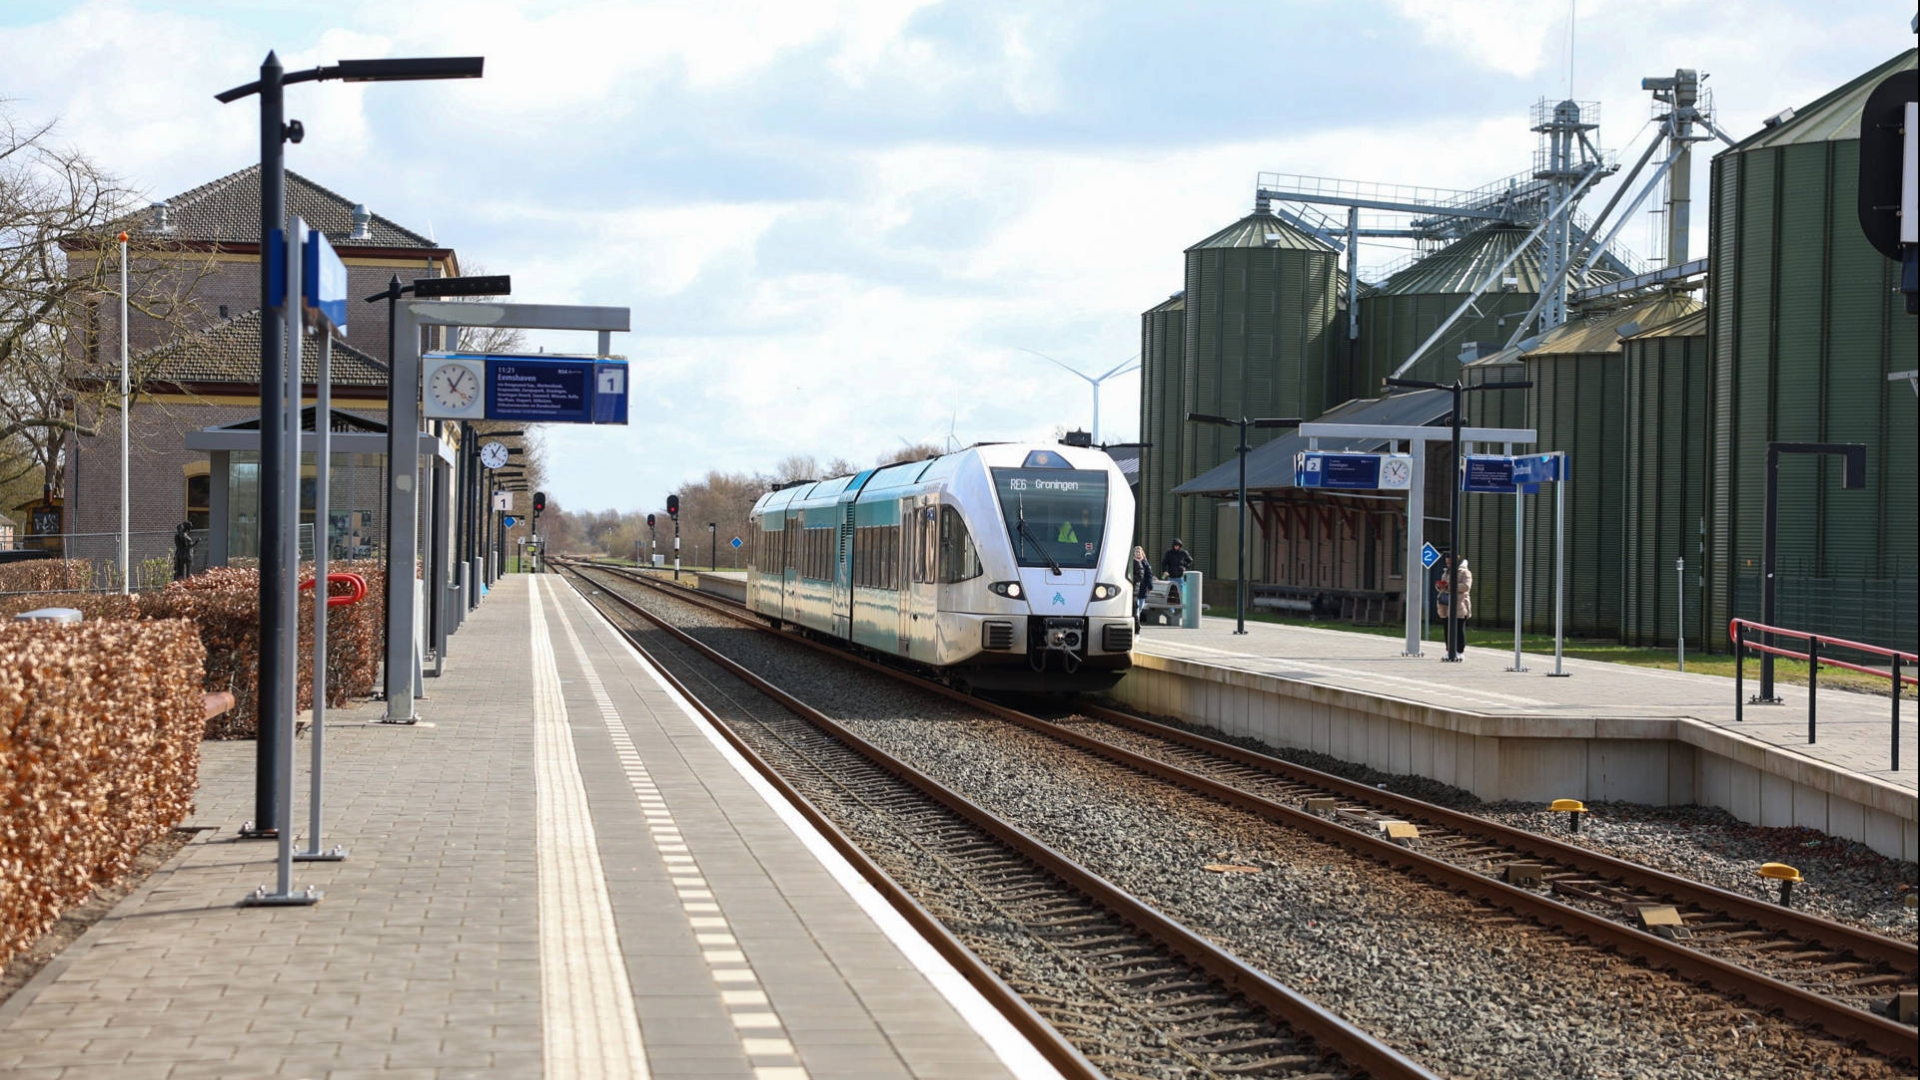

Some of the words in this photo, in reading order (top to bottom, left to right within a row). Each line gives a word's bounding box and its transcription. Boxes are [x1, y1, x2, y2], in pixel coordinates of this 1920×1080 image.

[607, 378, 614, 391] 1
[1010, 479, 1027, 490] RE6
[1035, 479, 1079, 491] Groningen
[500, 499, 506, 508] 1
[1424, 550, 1432, 561] 2
